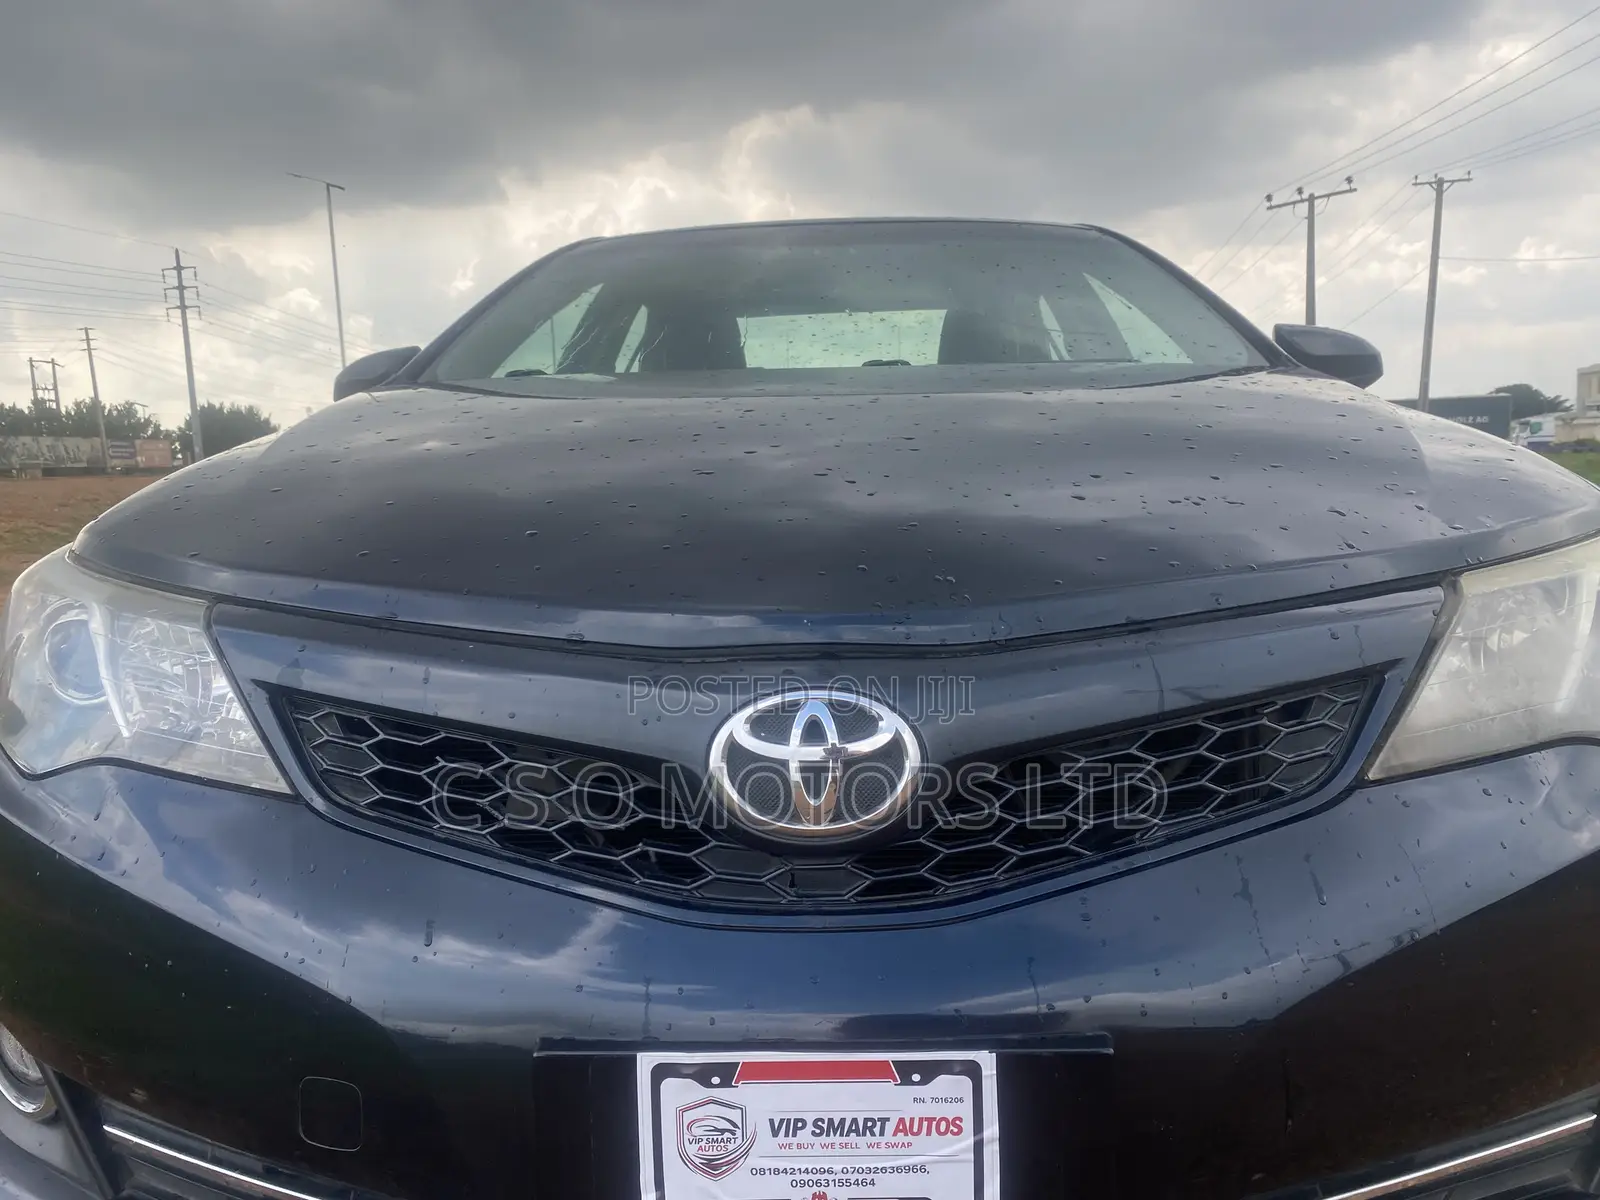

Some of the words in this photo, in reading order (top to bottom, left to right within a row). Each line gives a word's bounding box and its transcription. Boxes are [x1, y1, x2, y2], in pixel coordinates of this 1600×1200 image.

[769, 1117, 807, 1138] VIP
[811, 1117, 890, 1138] SMART
[892, 1116, 964, 1137] AUTOS
[705, 1136, 739, 1144] SMART
[697, 1144, 729, 1152] AUTOS
[778, 1142, 794, 1150] WE
[796, 1142, 816, 1150] BUY
[820, 1142, 836, 1150] WE
[838, 1142, 861, 1150] SELL
[866, 1141, 882, 1149] WE
[884, 1141, 913, 1149] SWAP
[750, 1167, 838, 1176] 08184214096,
[841, 1165, 930, 1175] 07032636966,
[790, 1178, 876, 1188] 09063155464
